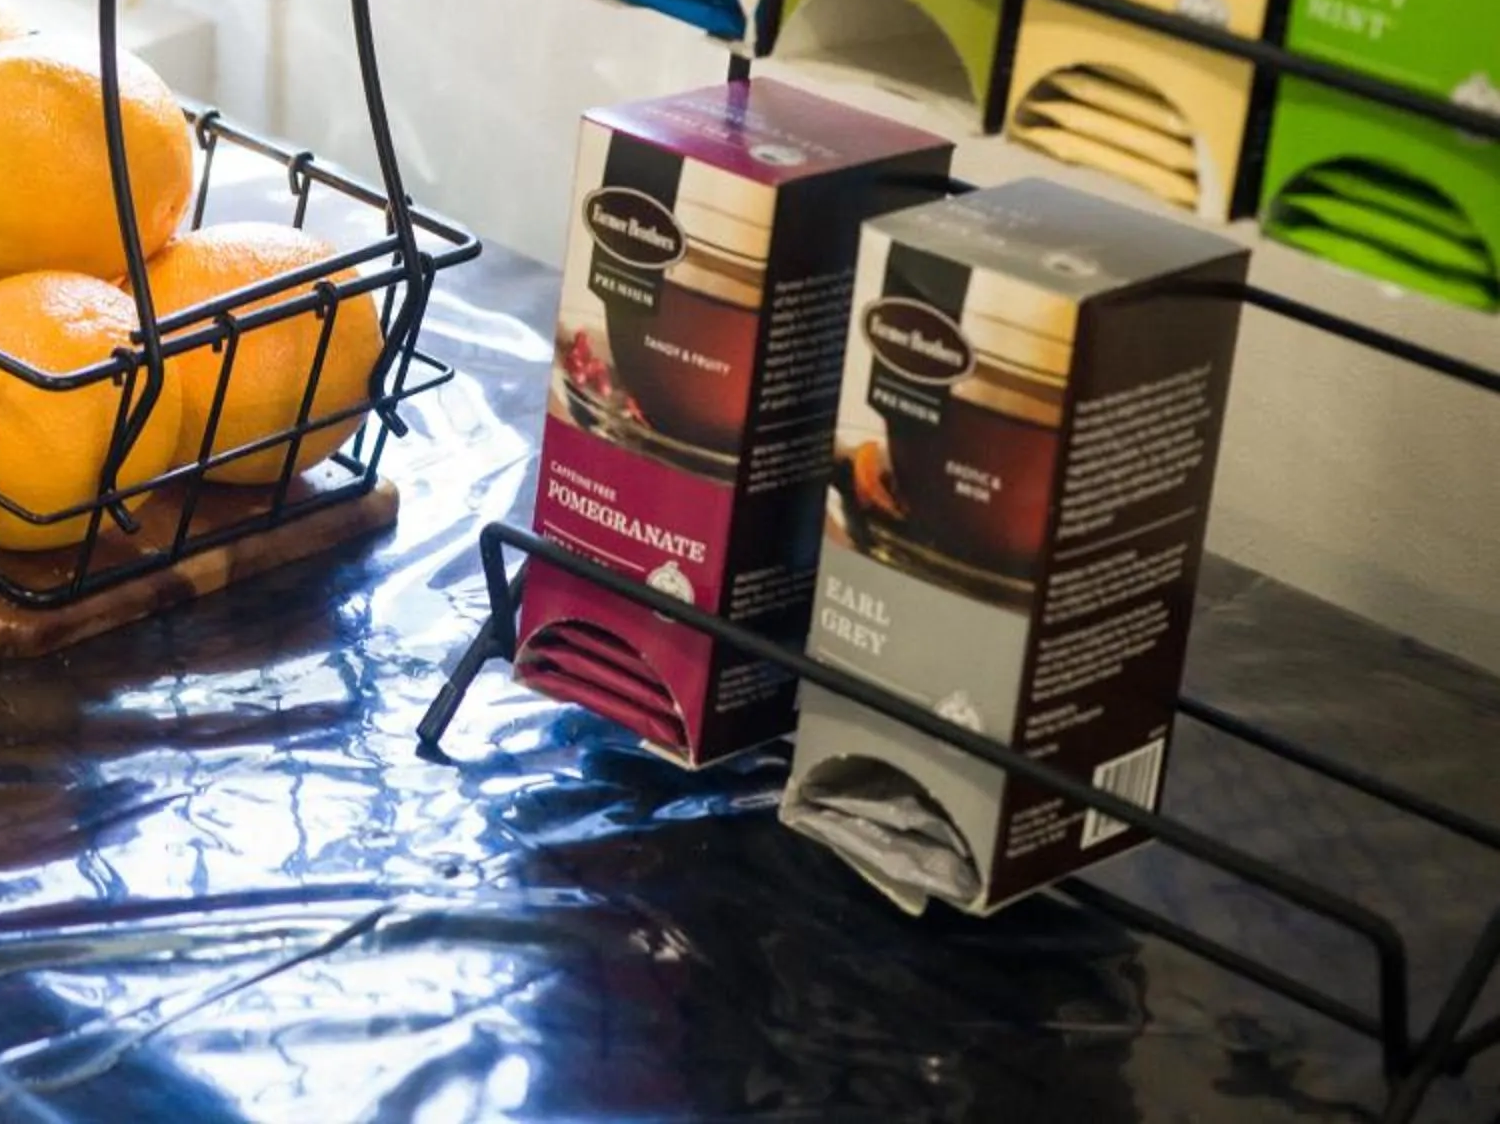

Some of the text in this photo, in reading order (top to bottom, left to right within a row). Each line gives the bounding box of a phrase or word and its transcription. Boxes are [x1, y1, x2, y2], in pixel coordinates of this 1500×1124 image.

[548, 478, 707, 564] POMEGRANATE
[826, 576, 891, 628] EARL
[821, 608, 887, 656] GREY
